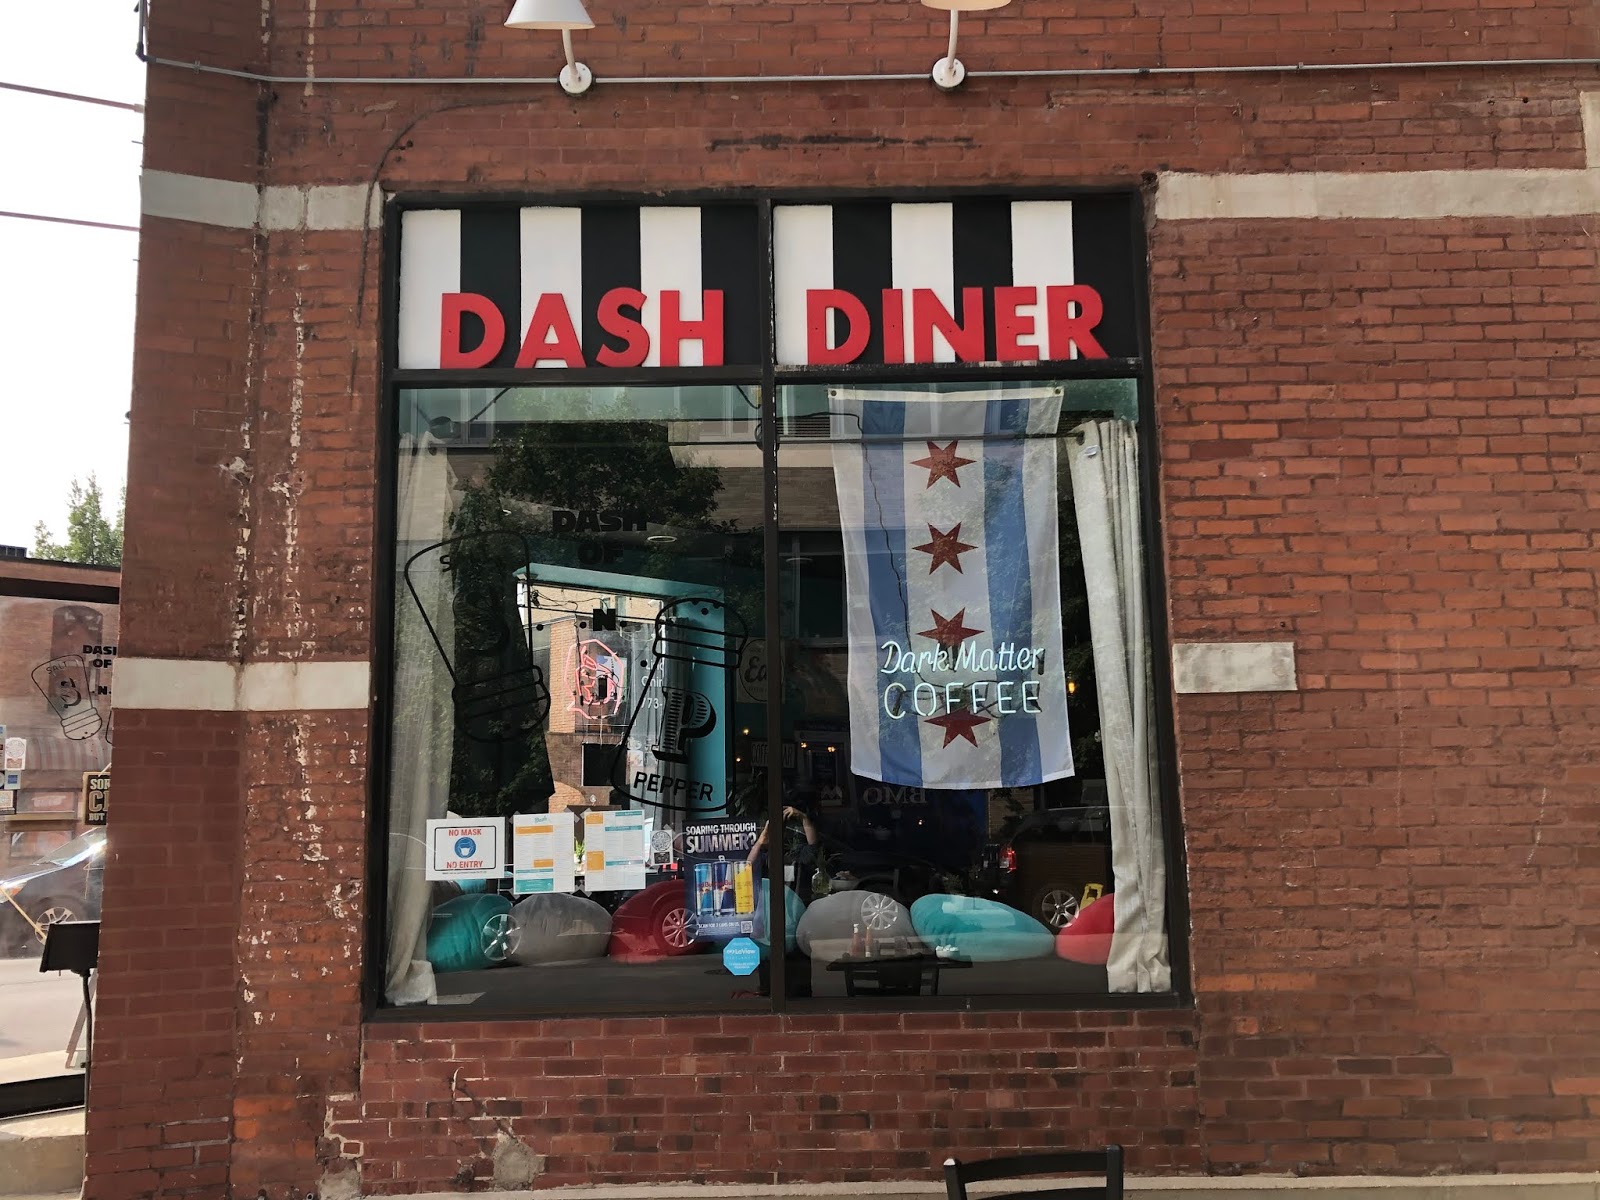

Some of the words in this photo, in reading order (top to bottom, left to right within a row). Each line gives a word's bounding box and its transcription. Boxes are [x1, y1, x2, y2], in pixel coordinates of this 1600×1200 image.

[440, 287, 724, 369] DASH
[806, 284, 1108, 365] DINER
[552, 510, 647, 532] DASH
[46, 661, 67, 674] SALT
[93, 658, 112, 668] OF
[881, 640, 949, 674] Dark
[955, 640, 1044, 672] Matter
[884, 681, 1042, 720] COFFEE
[633, 771, 714, 802] PEPPER
[686, 825, 719, 835] SOARING
[720, 823, 756, 833] THROUGH
[686, 832, 757, 854] SUMMER?
[459, 860, 483, 868] ENTRY
